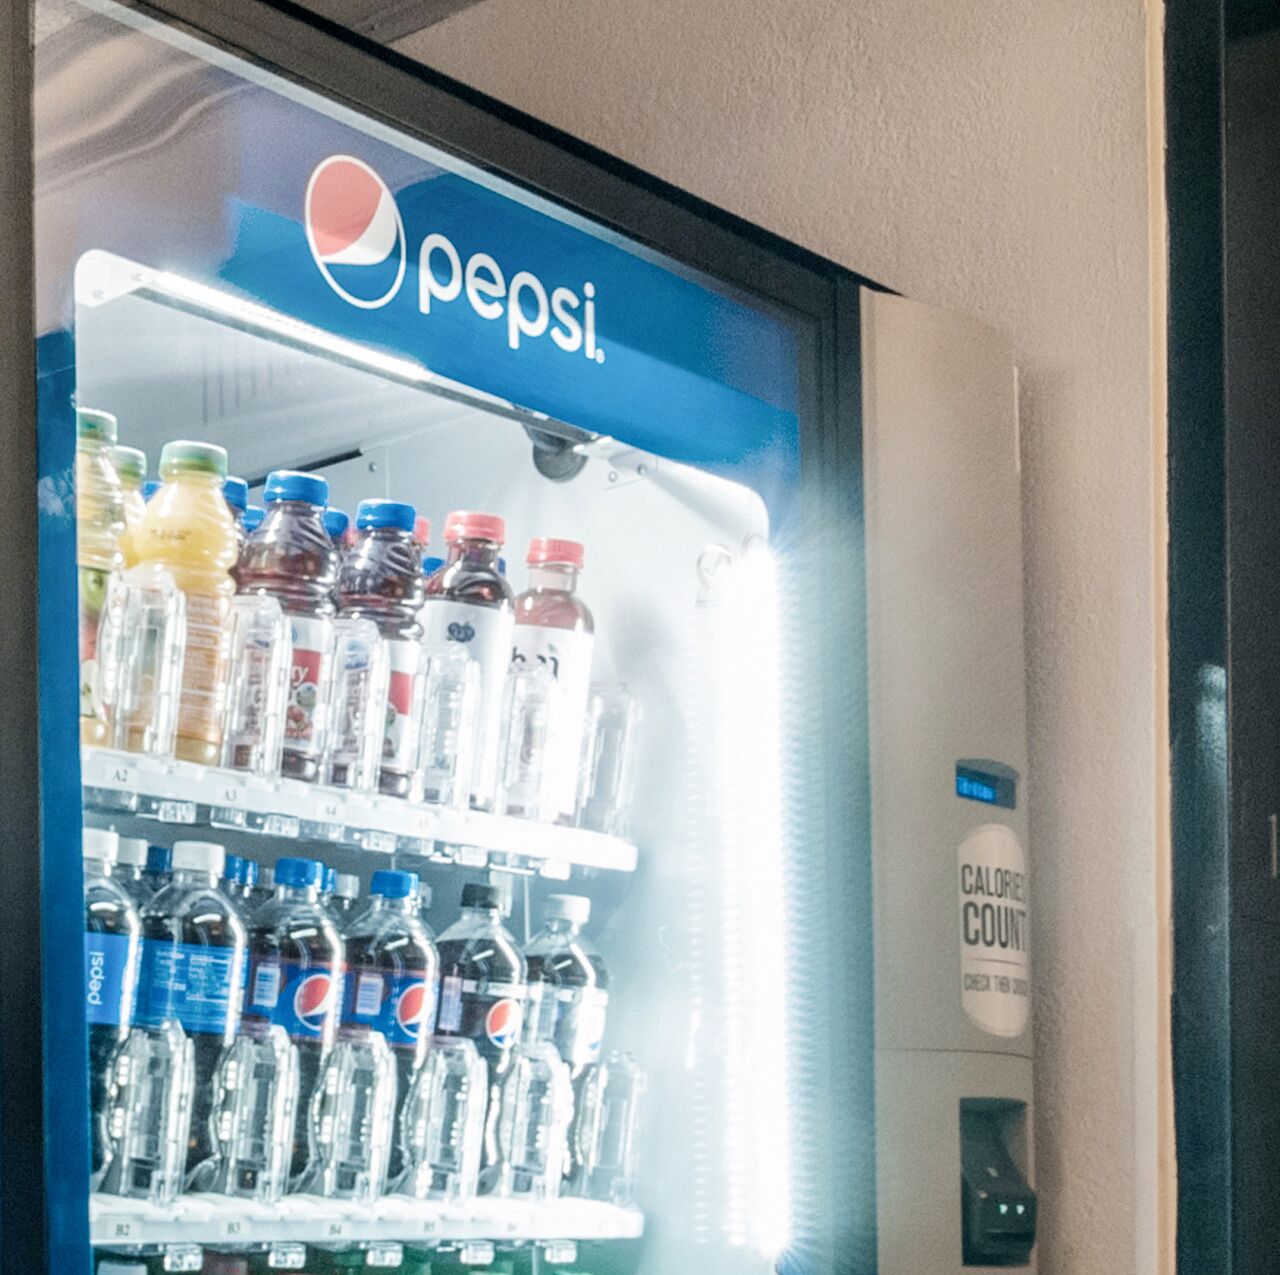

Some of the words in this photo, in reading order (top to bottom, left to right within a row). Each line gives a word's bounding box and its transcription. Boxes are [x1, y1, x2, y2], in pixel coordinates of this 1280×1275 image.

[962, 864, 1025, 902] CALORIE
[963, 902, 1026, 951] COUNT
[87, 951, 105, 1006] pepsi
